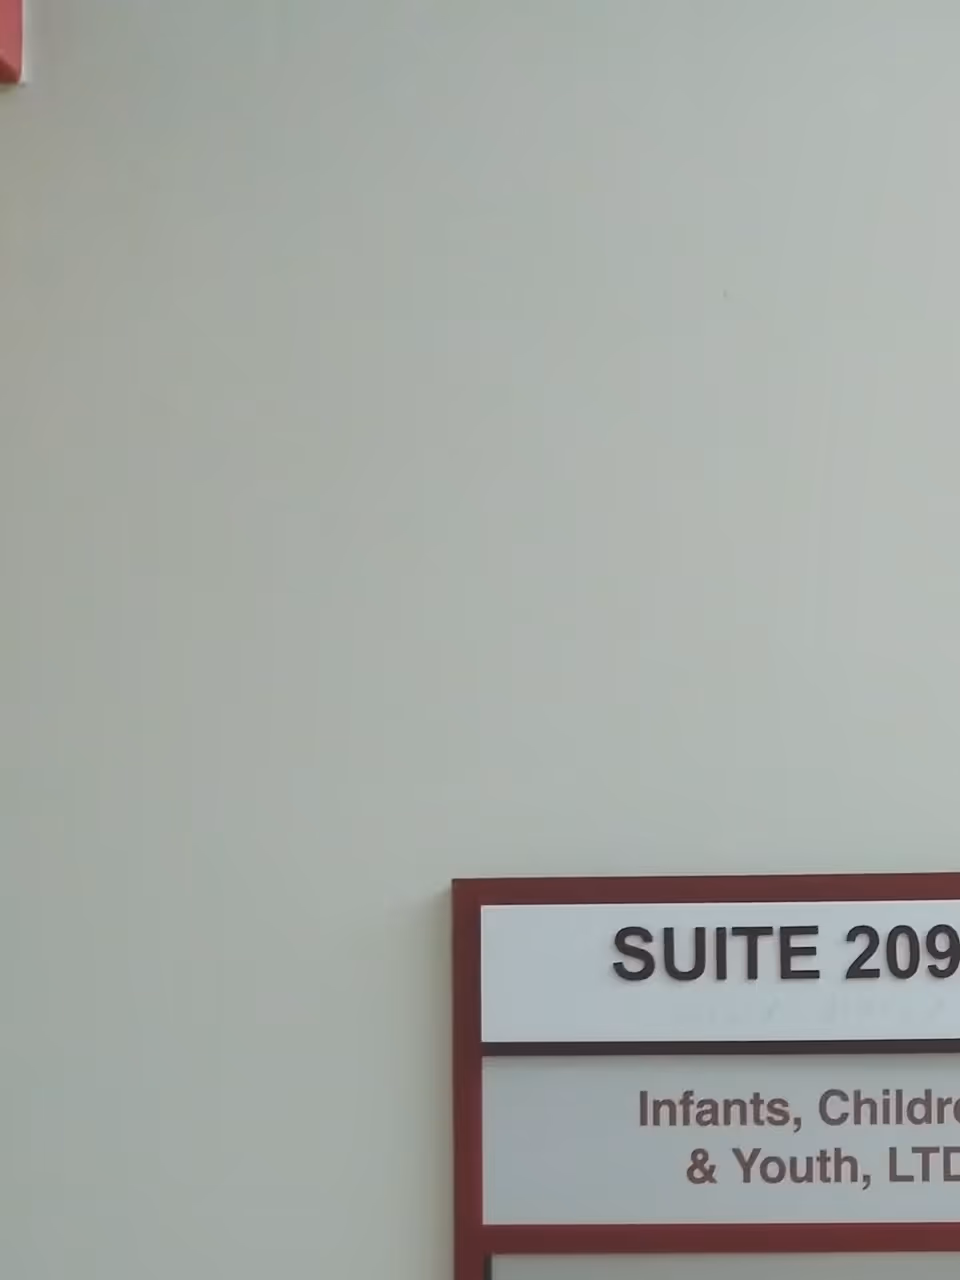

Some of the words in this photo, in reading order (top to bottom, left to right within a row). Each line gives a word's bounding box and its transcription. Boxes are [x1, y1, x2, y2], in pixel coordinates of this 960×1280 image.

[612, 924, 820, 982] SUITE
[638, 1090, 803, 1132] Infants,
[686, 1148, 717, 1184] &
[731, 1147, 872, 1191] Youth,
